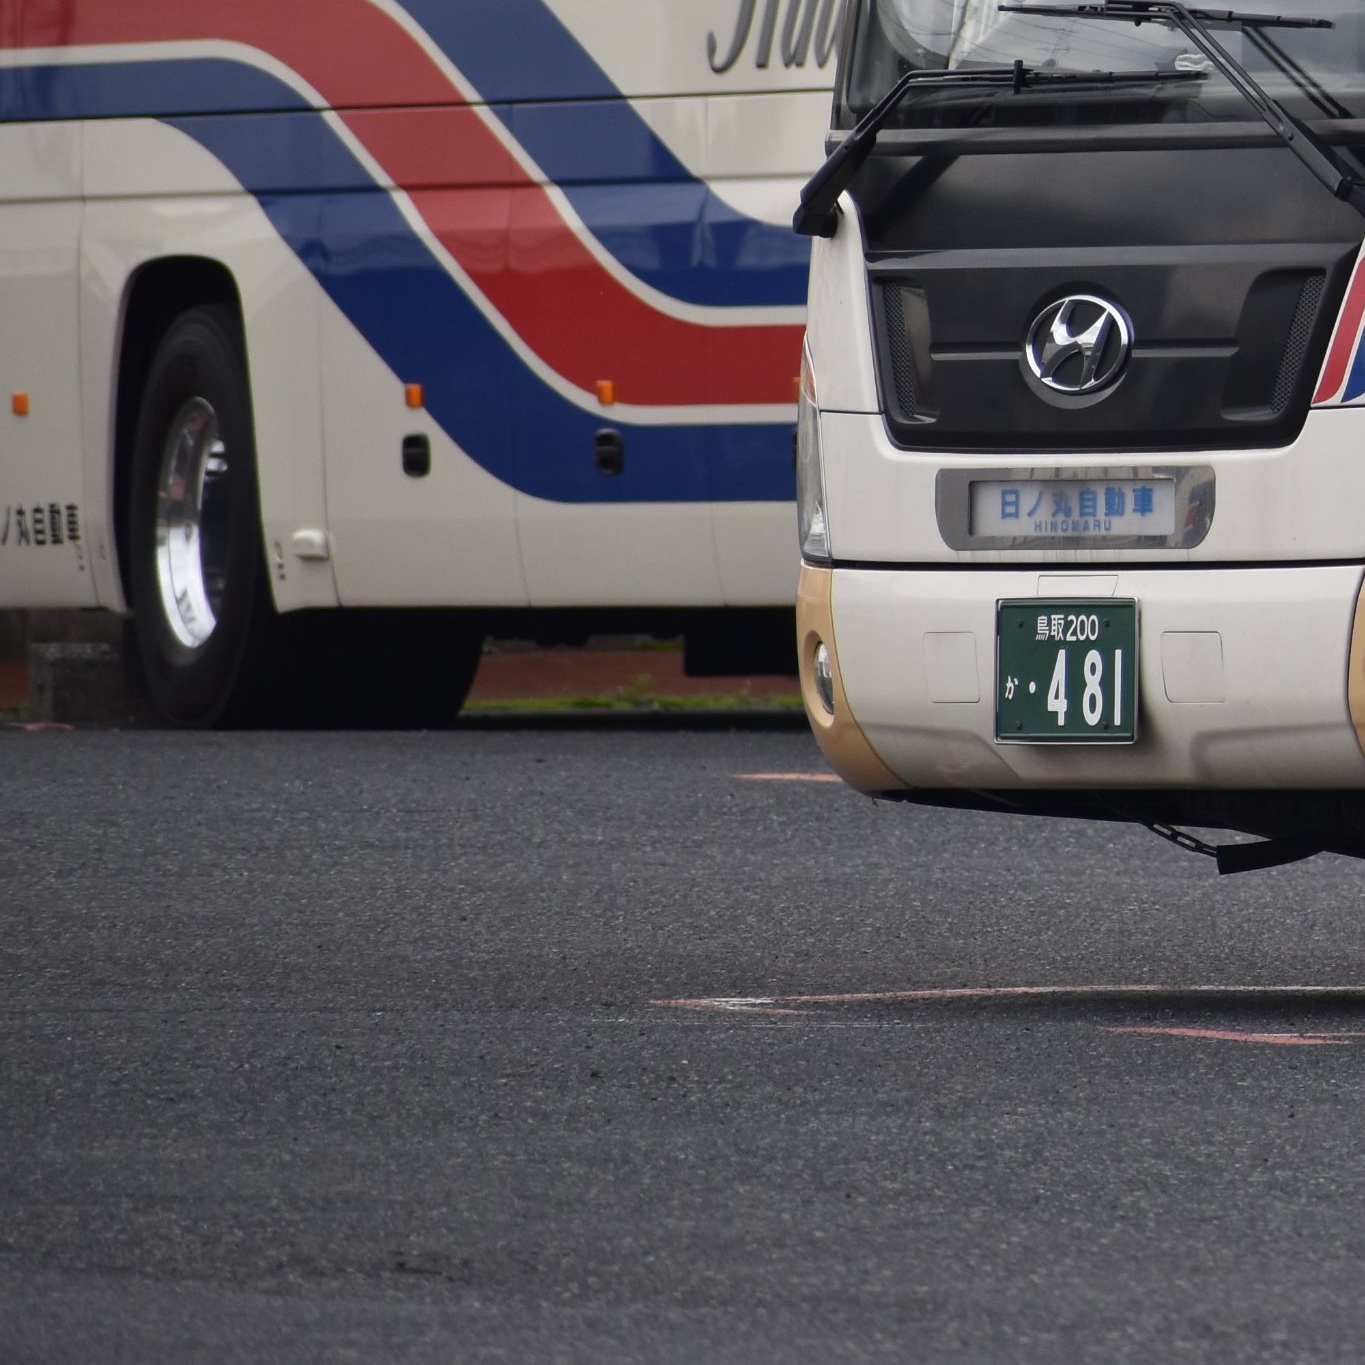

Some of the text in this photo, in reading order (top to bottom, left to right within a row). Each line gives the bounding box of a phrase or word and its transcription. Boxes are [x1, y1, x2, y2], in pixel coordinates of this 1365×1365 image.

[1001, 486, 1154, 519] 日ノ丸自動車
[1034, 519, 1112, 533] HINOMARU
